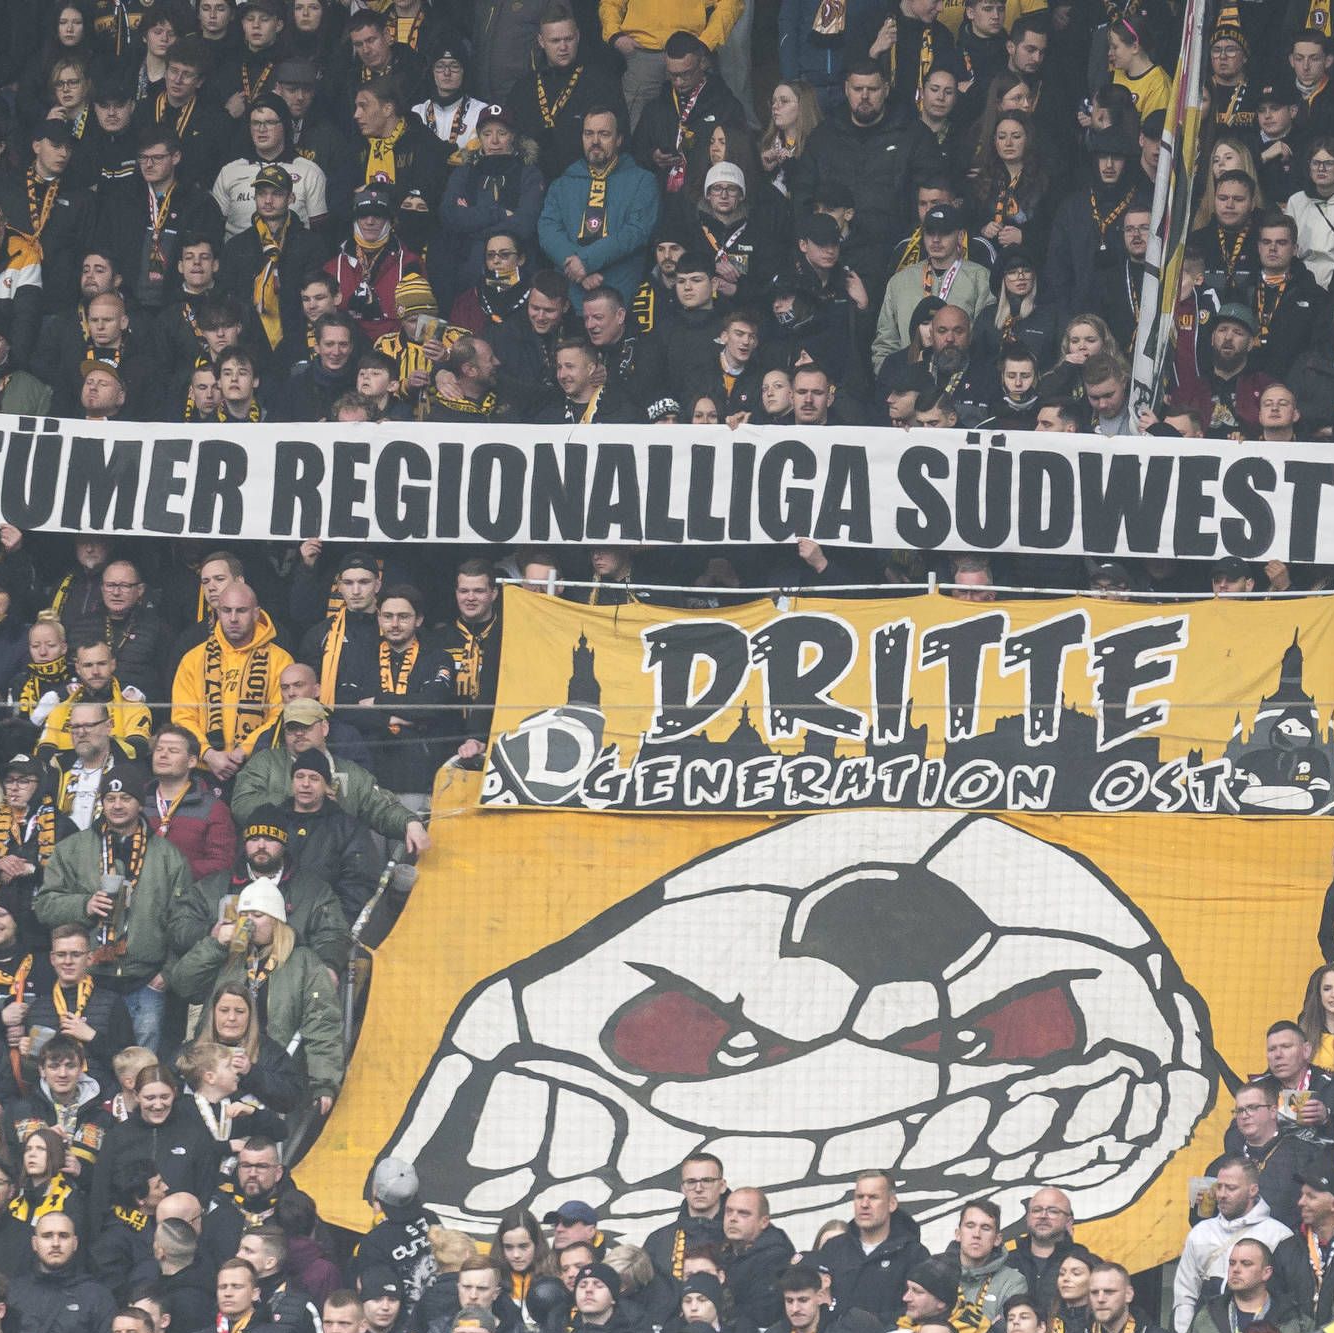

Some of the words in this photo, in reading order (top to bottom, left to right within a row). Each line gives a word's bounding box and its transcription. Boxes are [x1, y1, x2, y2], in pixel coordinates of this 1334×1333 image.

[270, 440, 873, 546] REGIONALLIGA
[641, 609, 1191, 752] DRITTE
[582, 744, 1058, 811] GENERATION
[1088, 754, 1236, 812] OST
